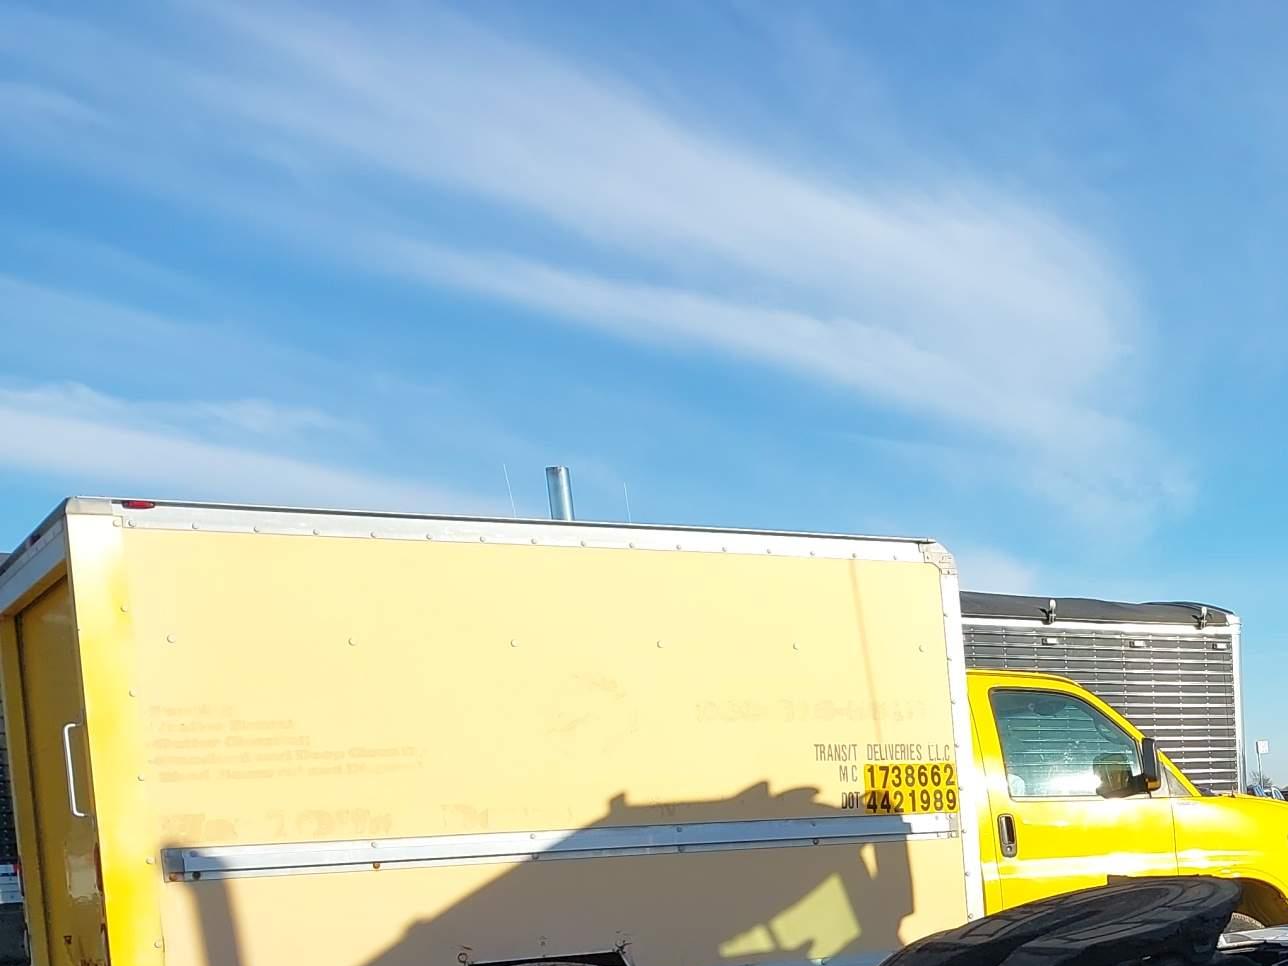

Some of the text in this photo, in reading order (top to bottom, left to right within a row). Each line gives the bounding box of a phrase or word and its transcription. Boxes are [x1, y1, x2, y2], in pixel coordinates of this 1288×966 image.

[814, 744, 858, 762] TRANSIT
[867, 744, 922, 762] DELIVERIES
[867, 764, 956, 789] 1738662
[841, 789, 957, 813] DOT 4421989
